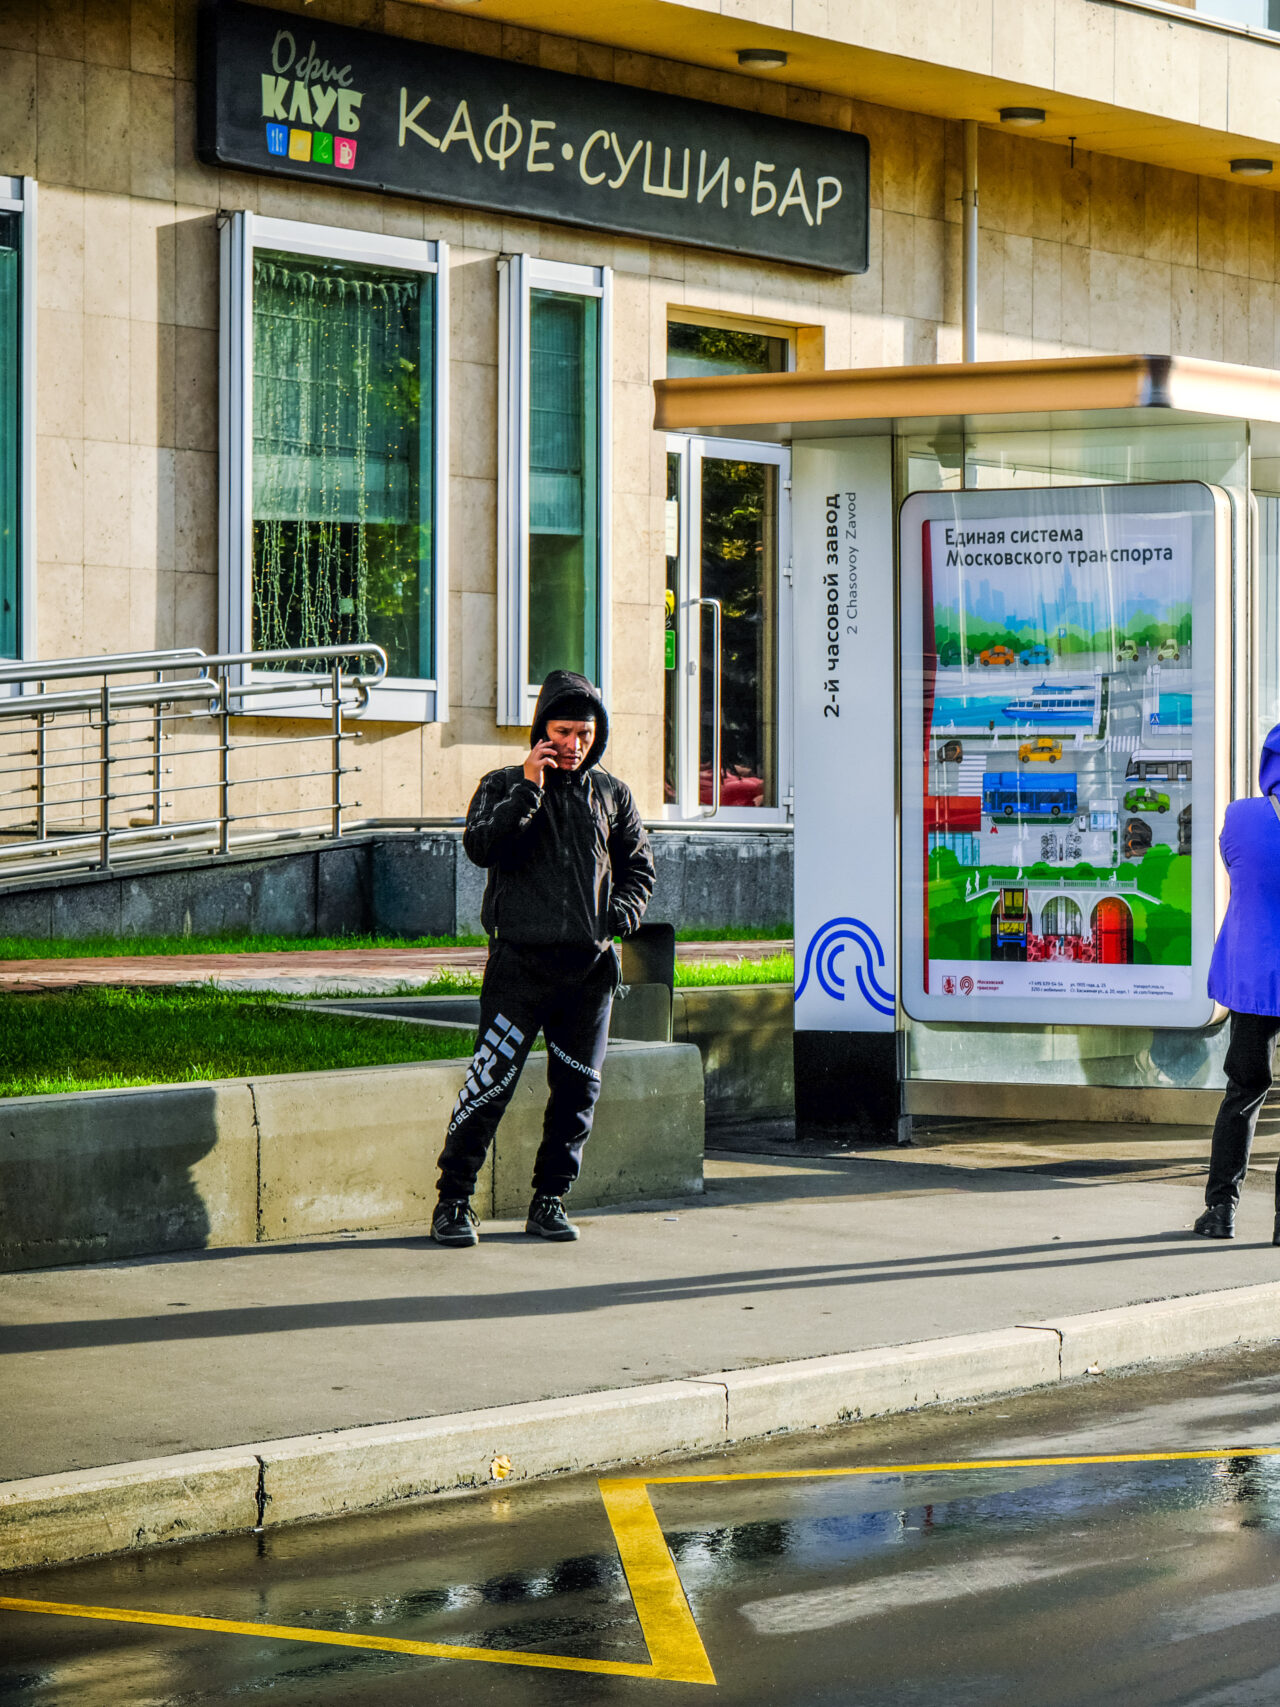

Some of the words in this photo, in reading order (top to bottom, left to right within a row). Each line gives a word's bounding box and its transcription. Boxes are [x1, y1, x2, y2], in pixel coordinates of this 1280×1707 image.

[271, 29, 354, 90] Офис
[261, 73, 364, 133] КЛУБ
[398, 86, 556, 173] КАФЕ
[579, 129, 730, 209] СУШИ
[750, 160, 843, 227] БАР
[826, 493, 841, 565] завод
[845, 491, 857, 540] Zavod
[945, 528, 1005, 548] Единая
[1010, 528, 1083, 544] система
[846, 545, 859, 620] Chasovoy
[946, 549, 1063, 567] Московского
[1067, 547, 1173, 567] транспорта
[823, 575, 840, 671] часовой
[846, 625, 858, 634] 2
[823, 679, 840, 718] 2-й
[500, 1064, 519, 1088] MAN
